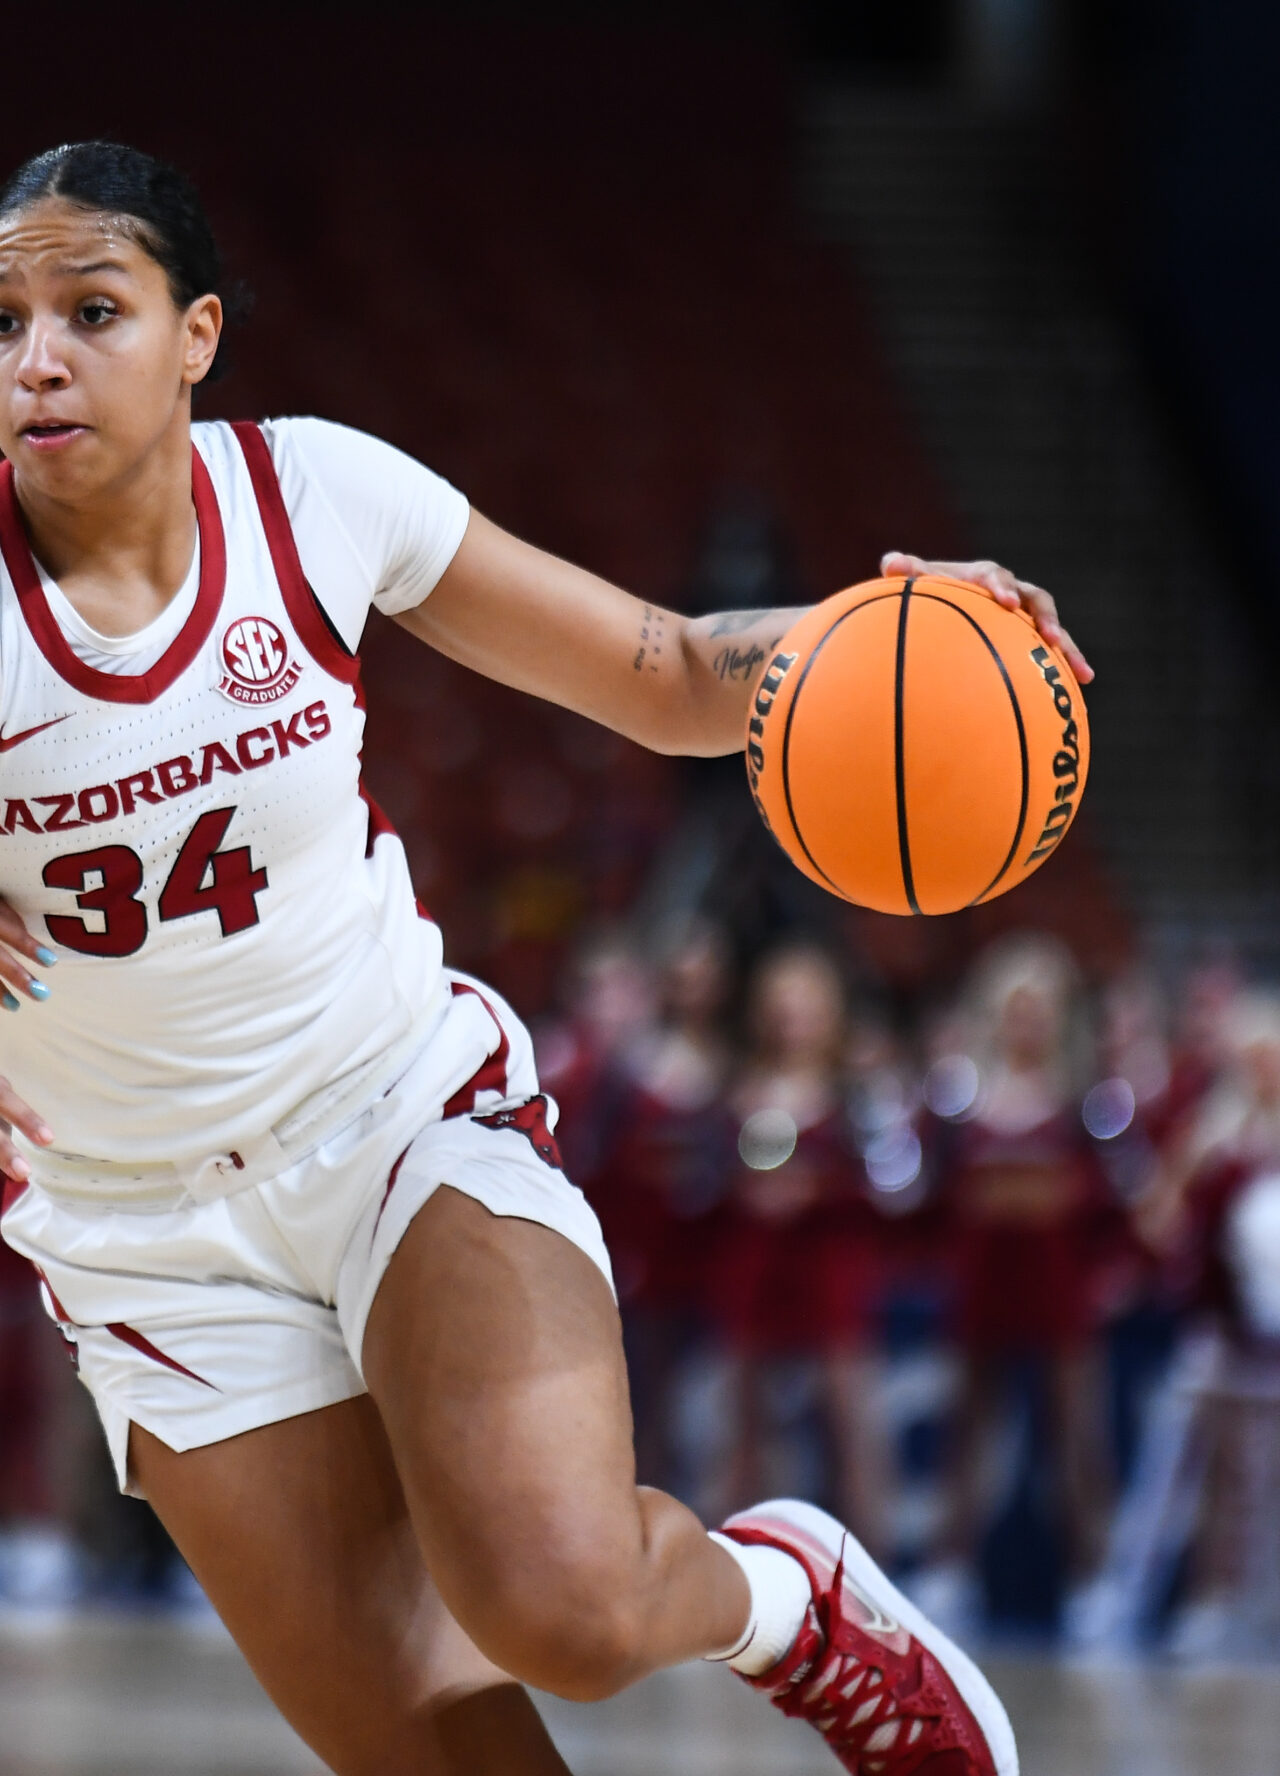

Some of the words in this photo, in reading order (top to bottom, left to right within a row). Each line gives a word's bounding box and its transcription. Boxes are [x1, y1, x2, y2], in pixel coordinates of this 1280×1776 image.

[226, 620, 283, 681] SEC
[233, 675, 295, 702] GRADUATE
[1024, 643, 1080, 867] Wilson
[41, 804, 269, 958] 34
